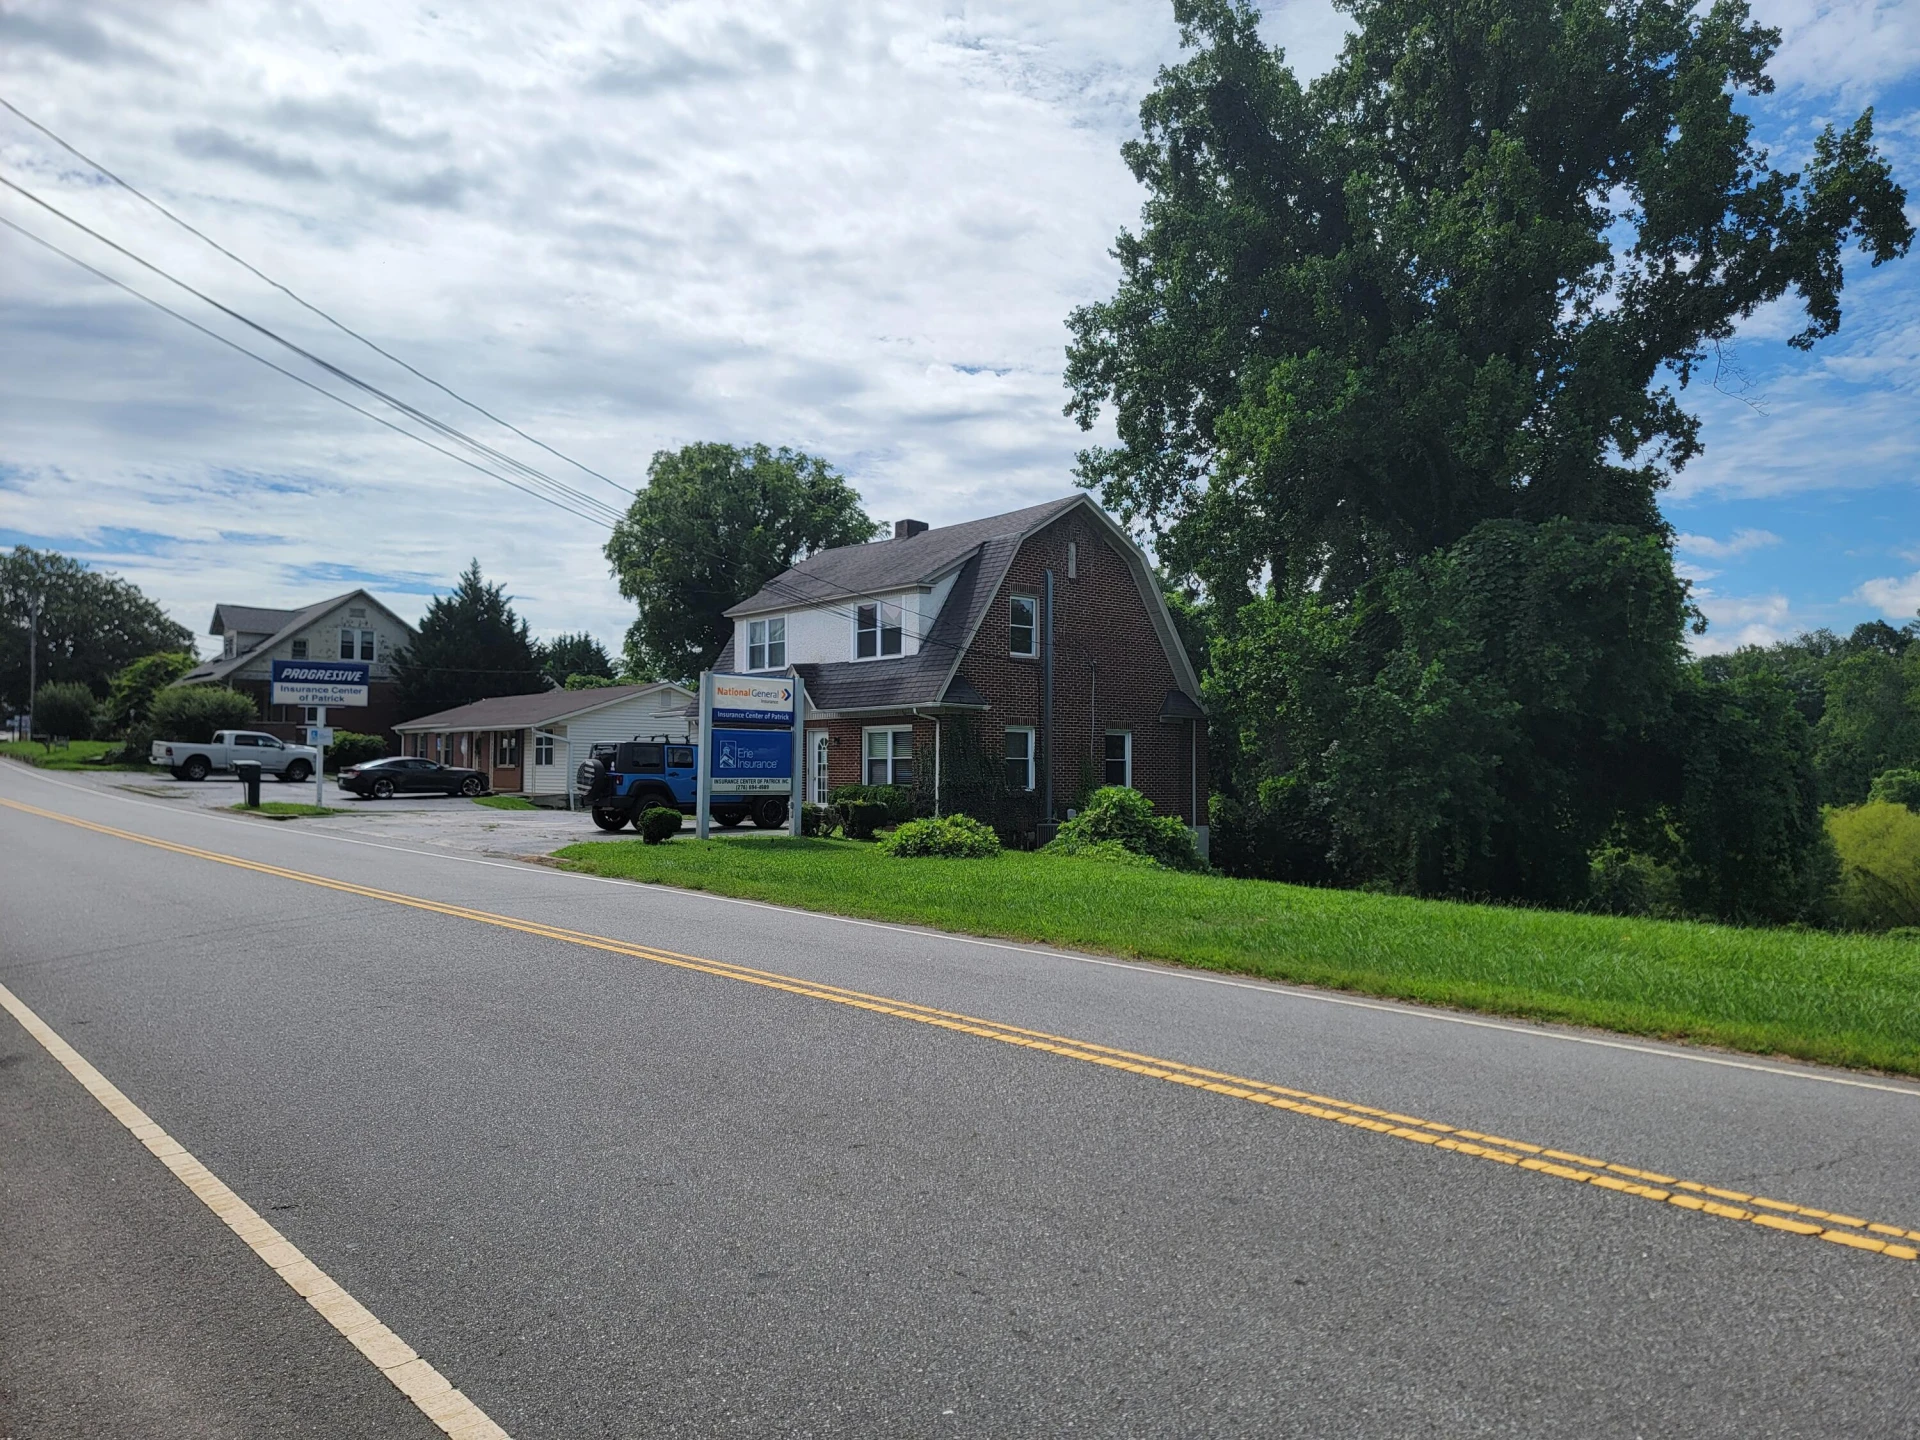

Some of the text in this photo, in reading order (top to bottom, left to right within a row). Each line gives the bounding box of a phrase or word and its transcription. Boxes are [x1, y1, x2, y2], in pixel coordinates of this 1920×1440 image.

[281, 668, 363, 681] PROGRESSIVE
[280, 685, 362, 695] Insurance Center
[717, 687, 779, 699] National General
[311, 695, 344, 703] Patrick
[737, 748, 753, 758] Erie
[737, 759, 777, 769] Insurance
